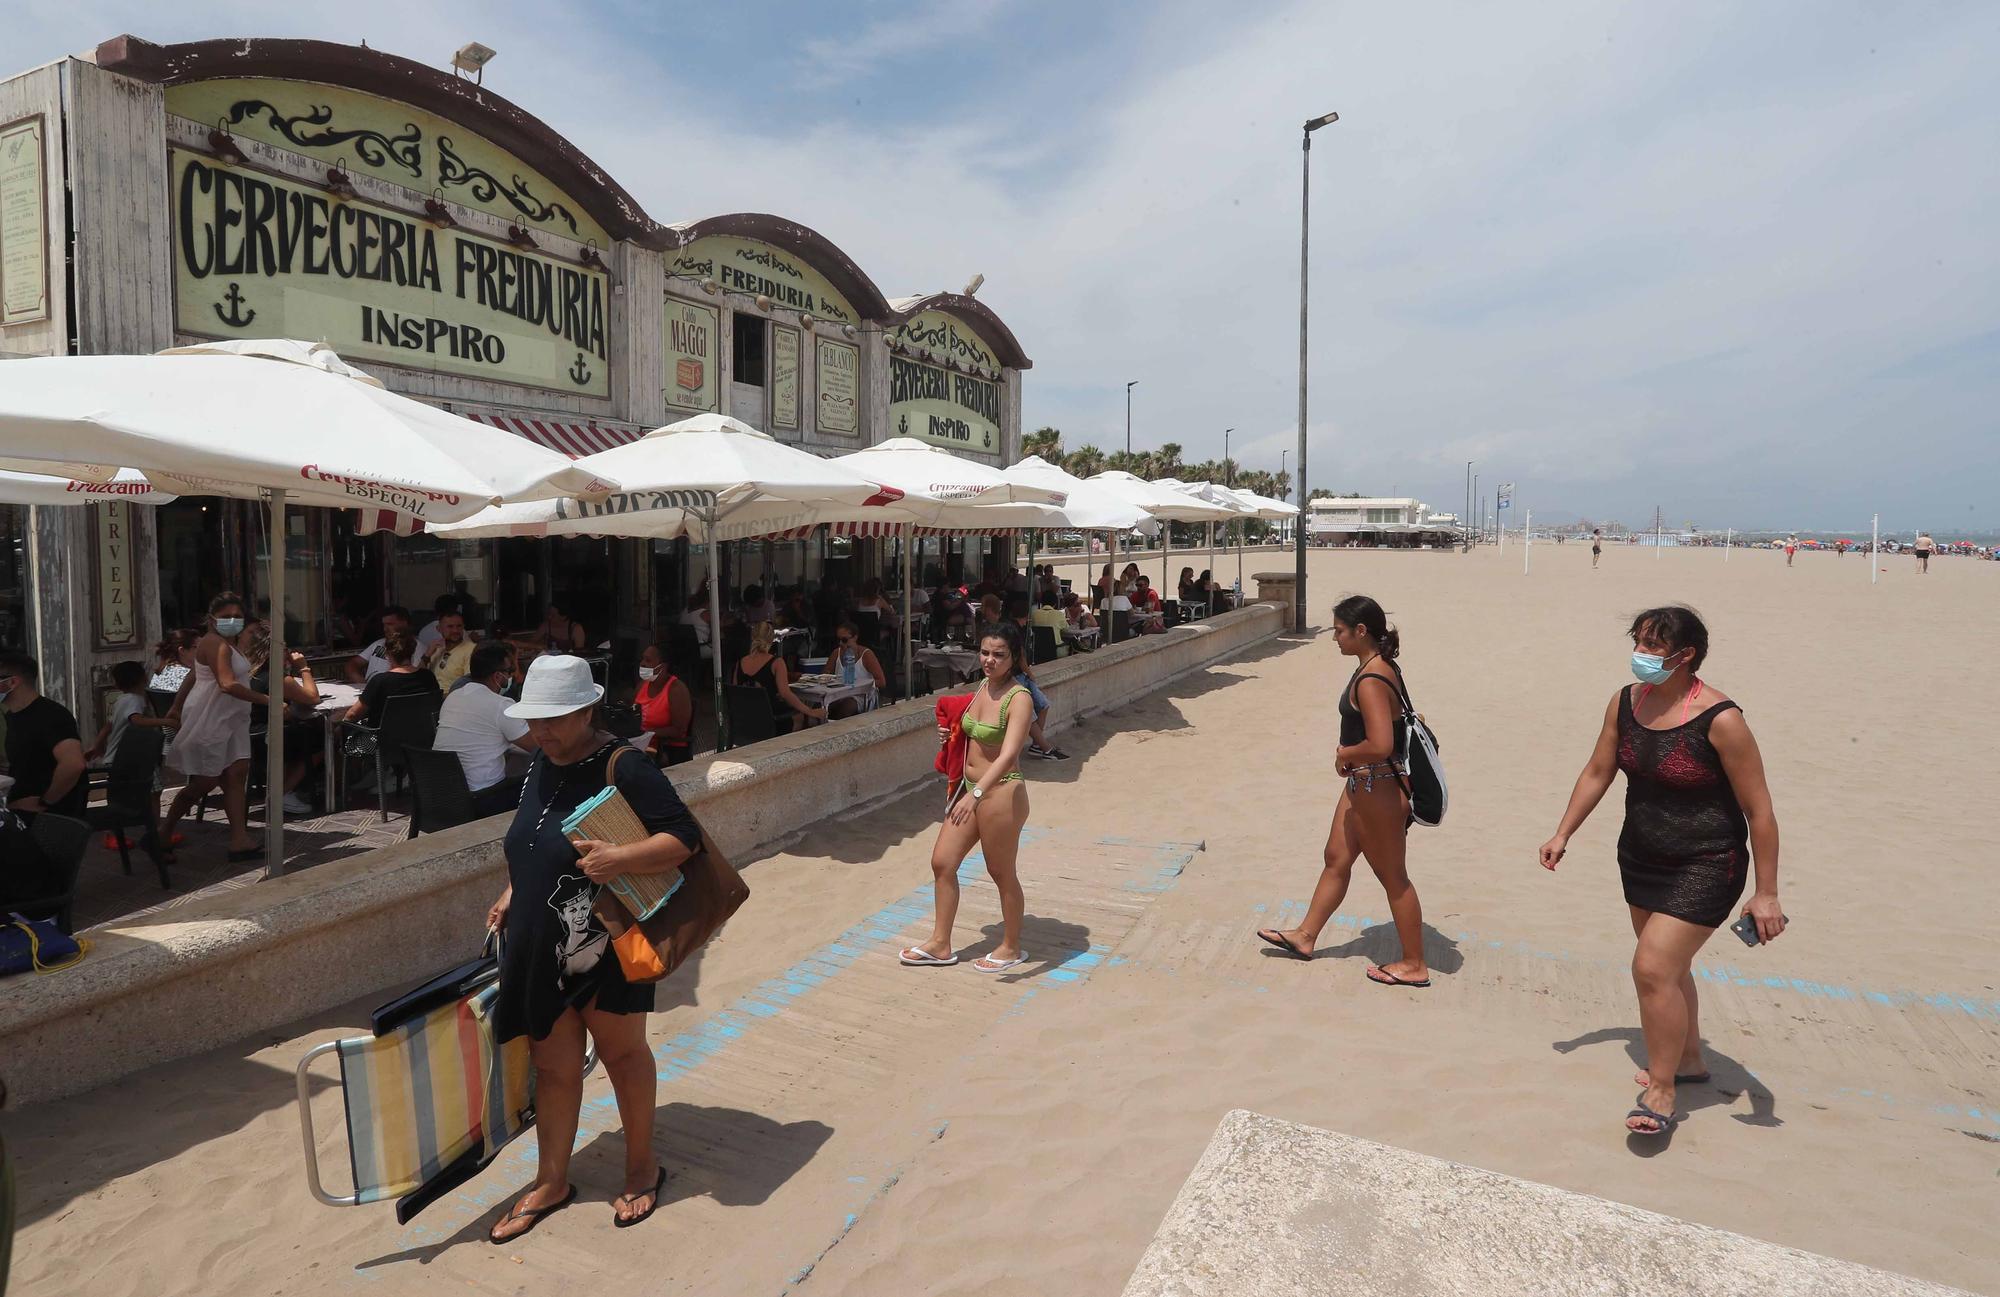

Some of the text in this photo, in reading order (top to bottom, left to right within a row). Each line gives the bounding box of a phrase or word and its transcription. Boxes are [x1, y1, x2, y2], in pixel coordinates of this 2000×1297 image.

[180, 159, 606, 362] CERVECERIA FREIDURIA
[721, 264, 814, 312] FREIDURIA
[361, 304, 506, 365] INSPIRO
[670, 318, 707, 358] MAGGI
[928, 414, 970, 442] INSPIRO
[345, 484, 426, 516] ESPECIAL
[108, 501, 123, 626] ERVEZA
